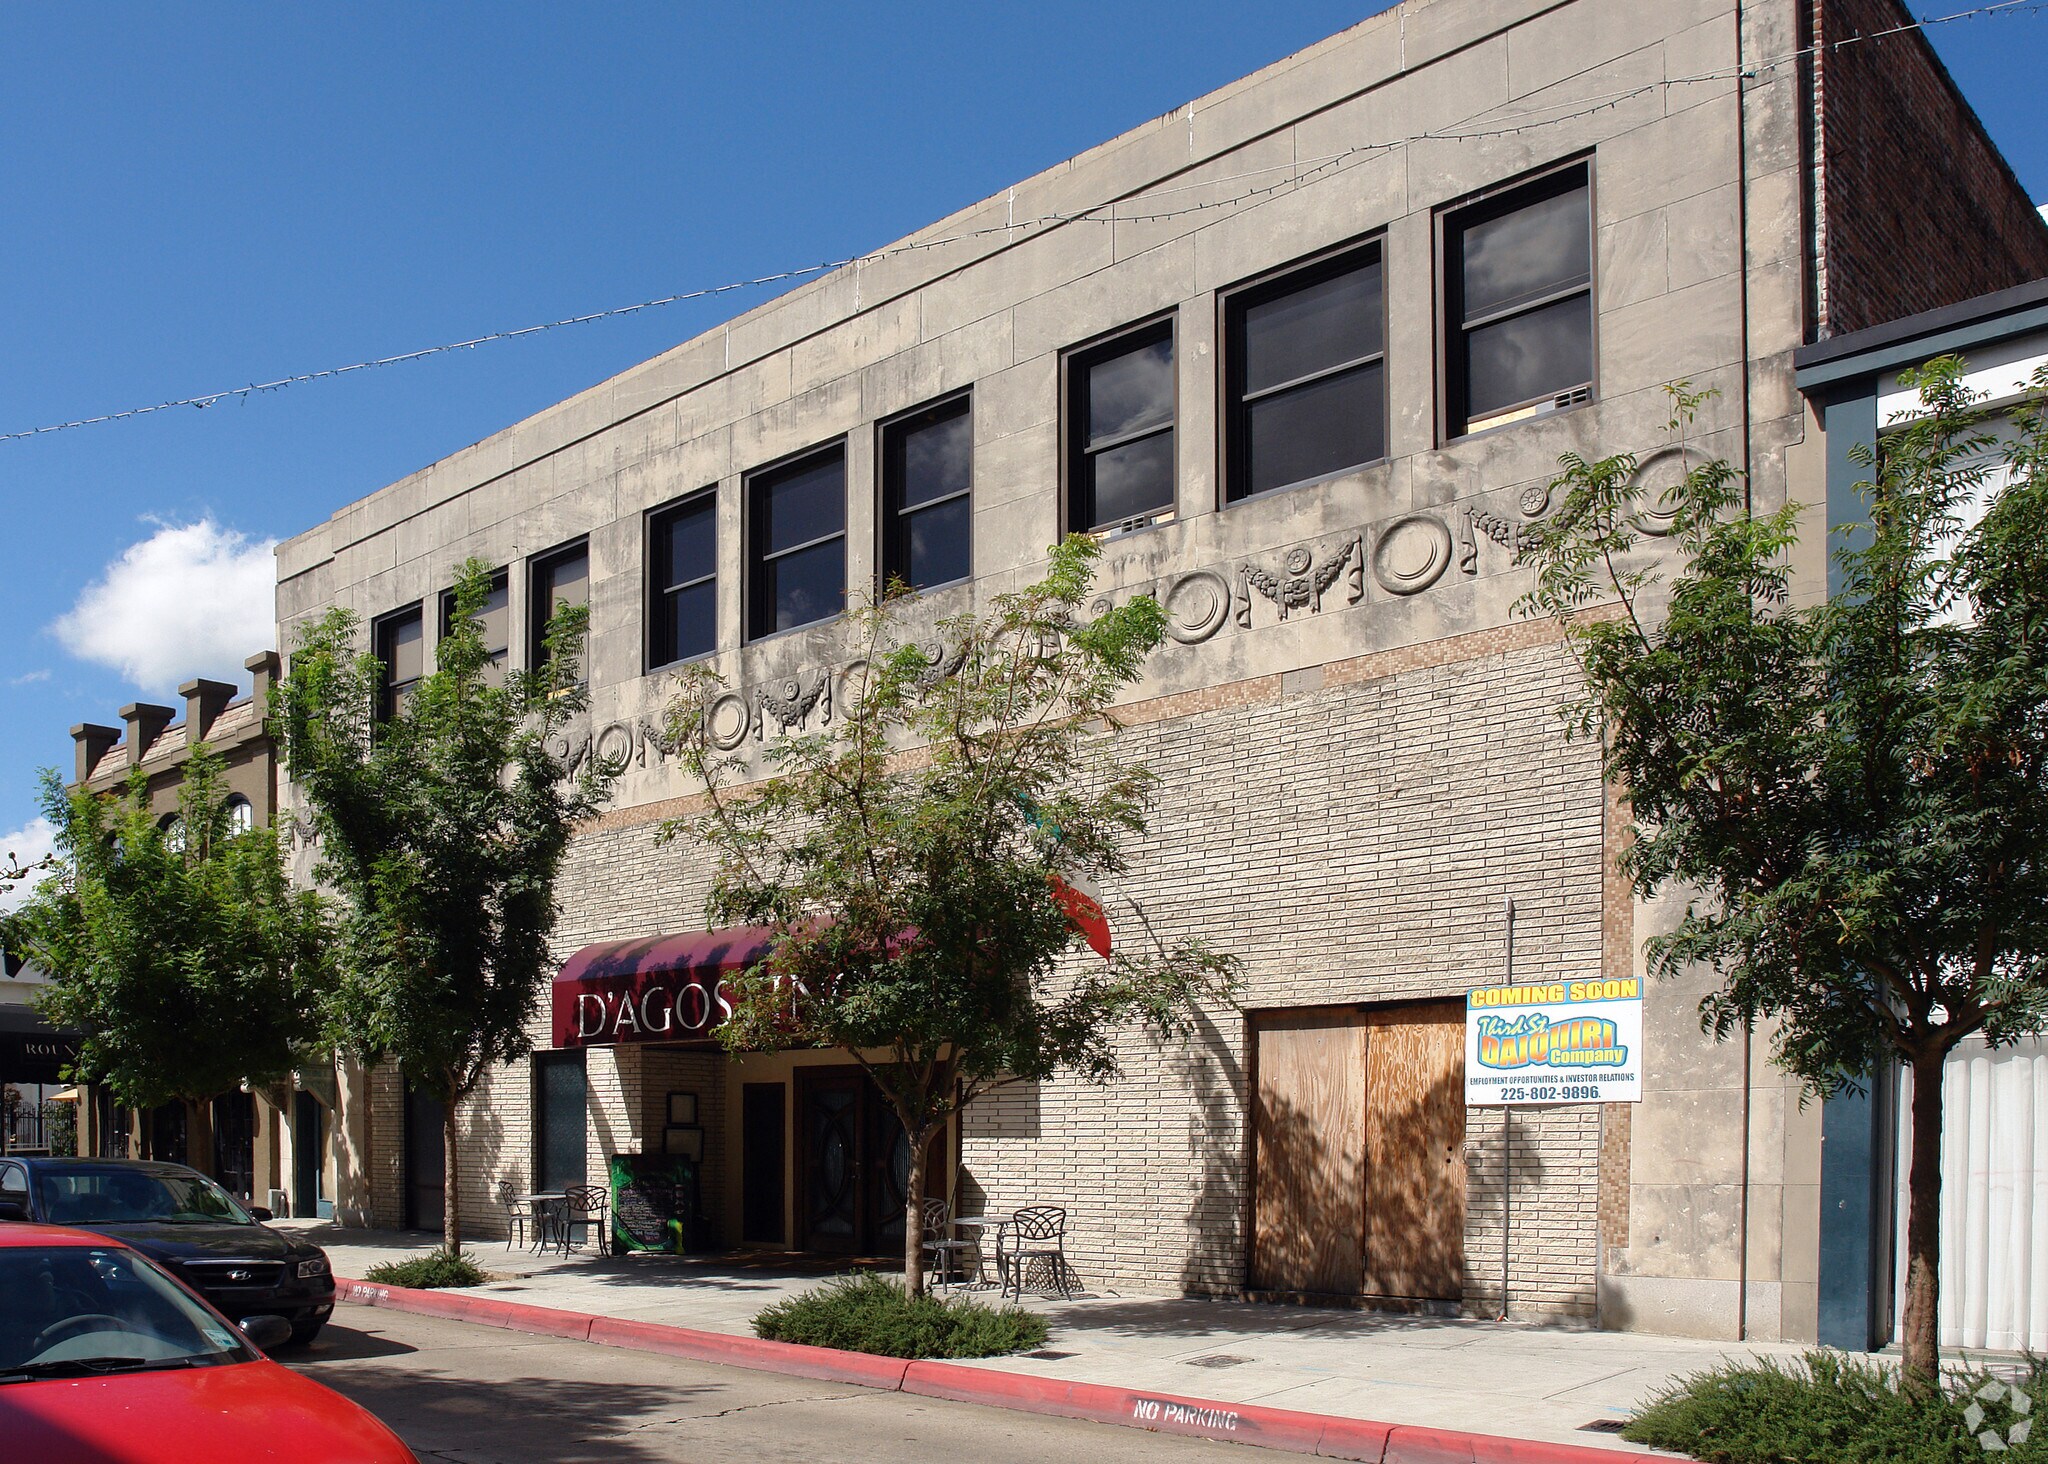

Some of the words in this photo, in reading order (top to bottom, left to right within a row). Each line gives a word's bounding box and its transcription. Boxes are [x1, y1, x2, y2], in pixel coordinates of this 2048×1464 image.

[1470, 984, 1564, 1007] COMING
[1569, 979, 1638, 1001] SOON
[576, 972, 862, 1040] D'AGOSN
[1480, 1015, 1525, 1036] Third
[1527, 1014, 1550, 1034] St.
[1481, 1020, 1614, 1066] DAIQUIRI
[1550, 1048, 1624, 1065] Company
[1470, 1077, 1508, 1086] EMPLOYMENT
[1509, 1075, 1558, 1084] OPPORTUNITIES
[1565, 1074, 1598, 1083] INVESTOR
[1599, 1073, 1635, 1082] RELATIONS
[352, 1285, 362, 1297] NO
[361, 1286, 389, 1301] PARKING
[1133, 1400, 1160, 1420] NO
[1164, 1403, 1238, 1431] PARKING
